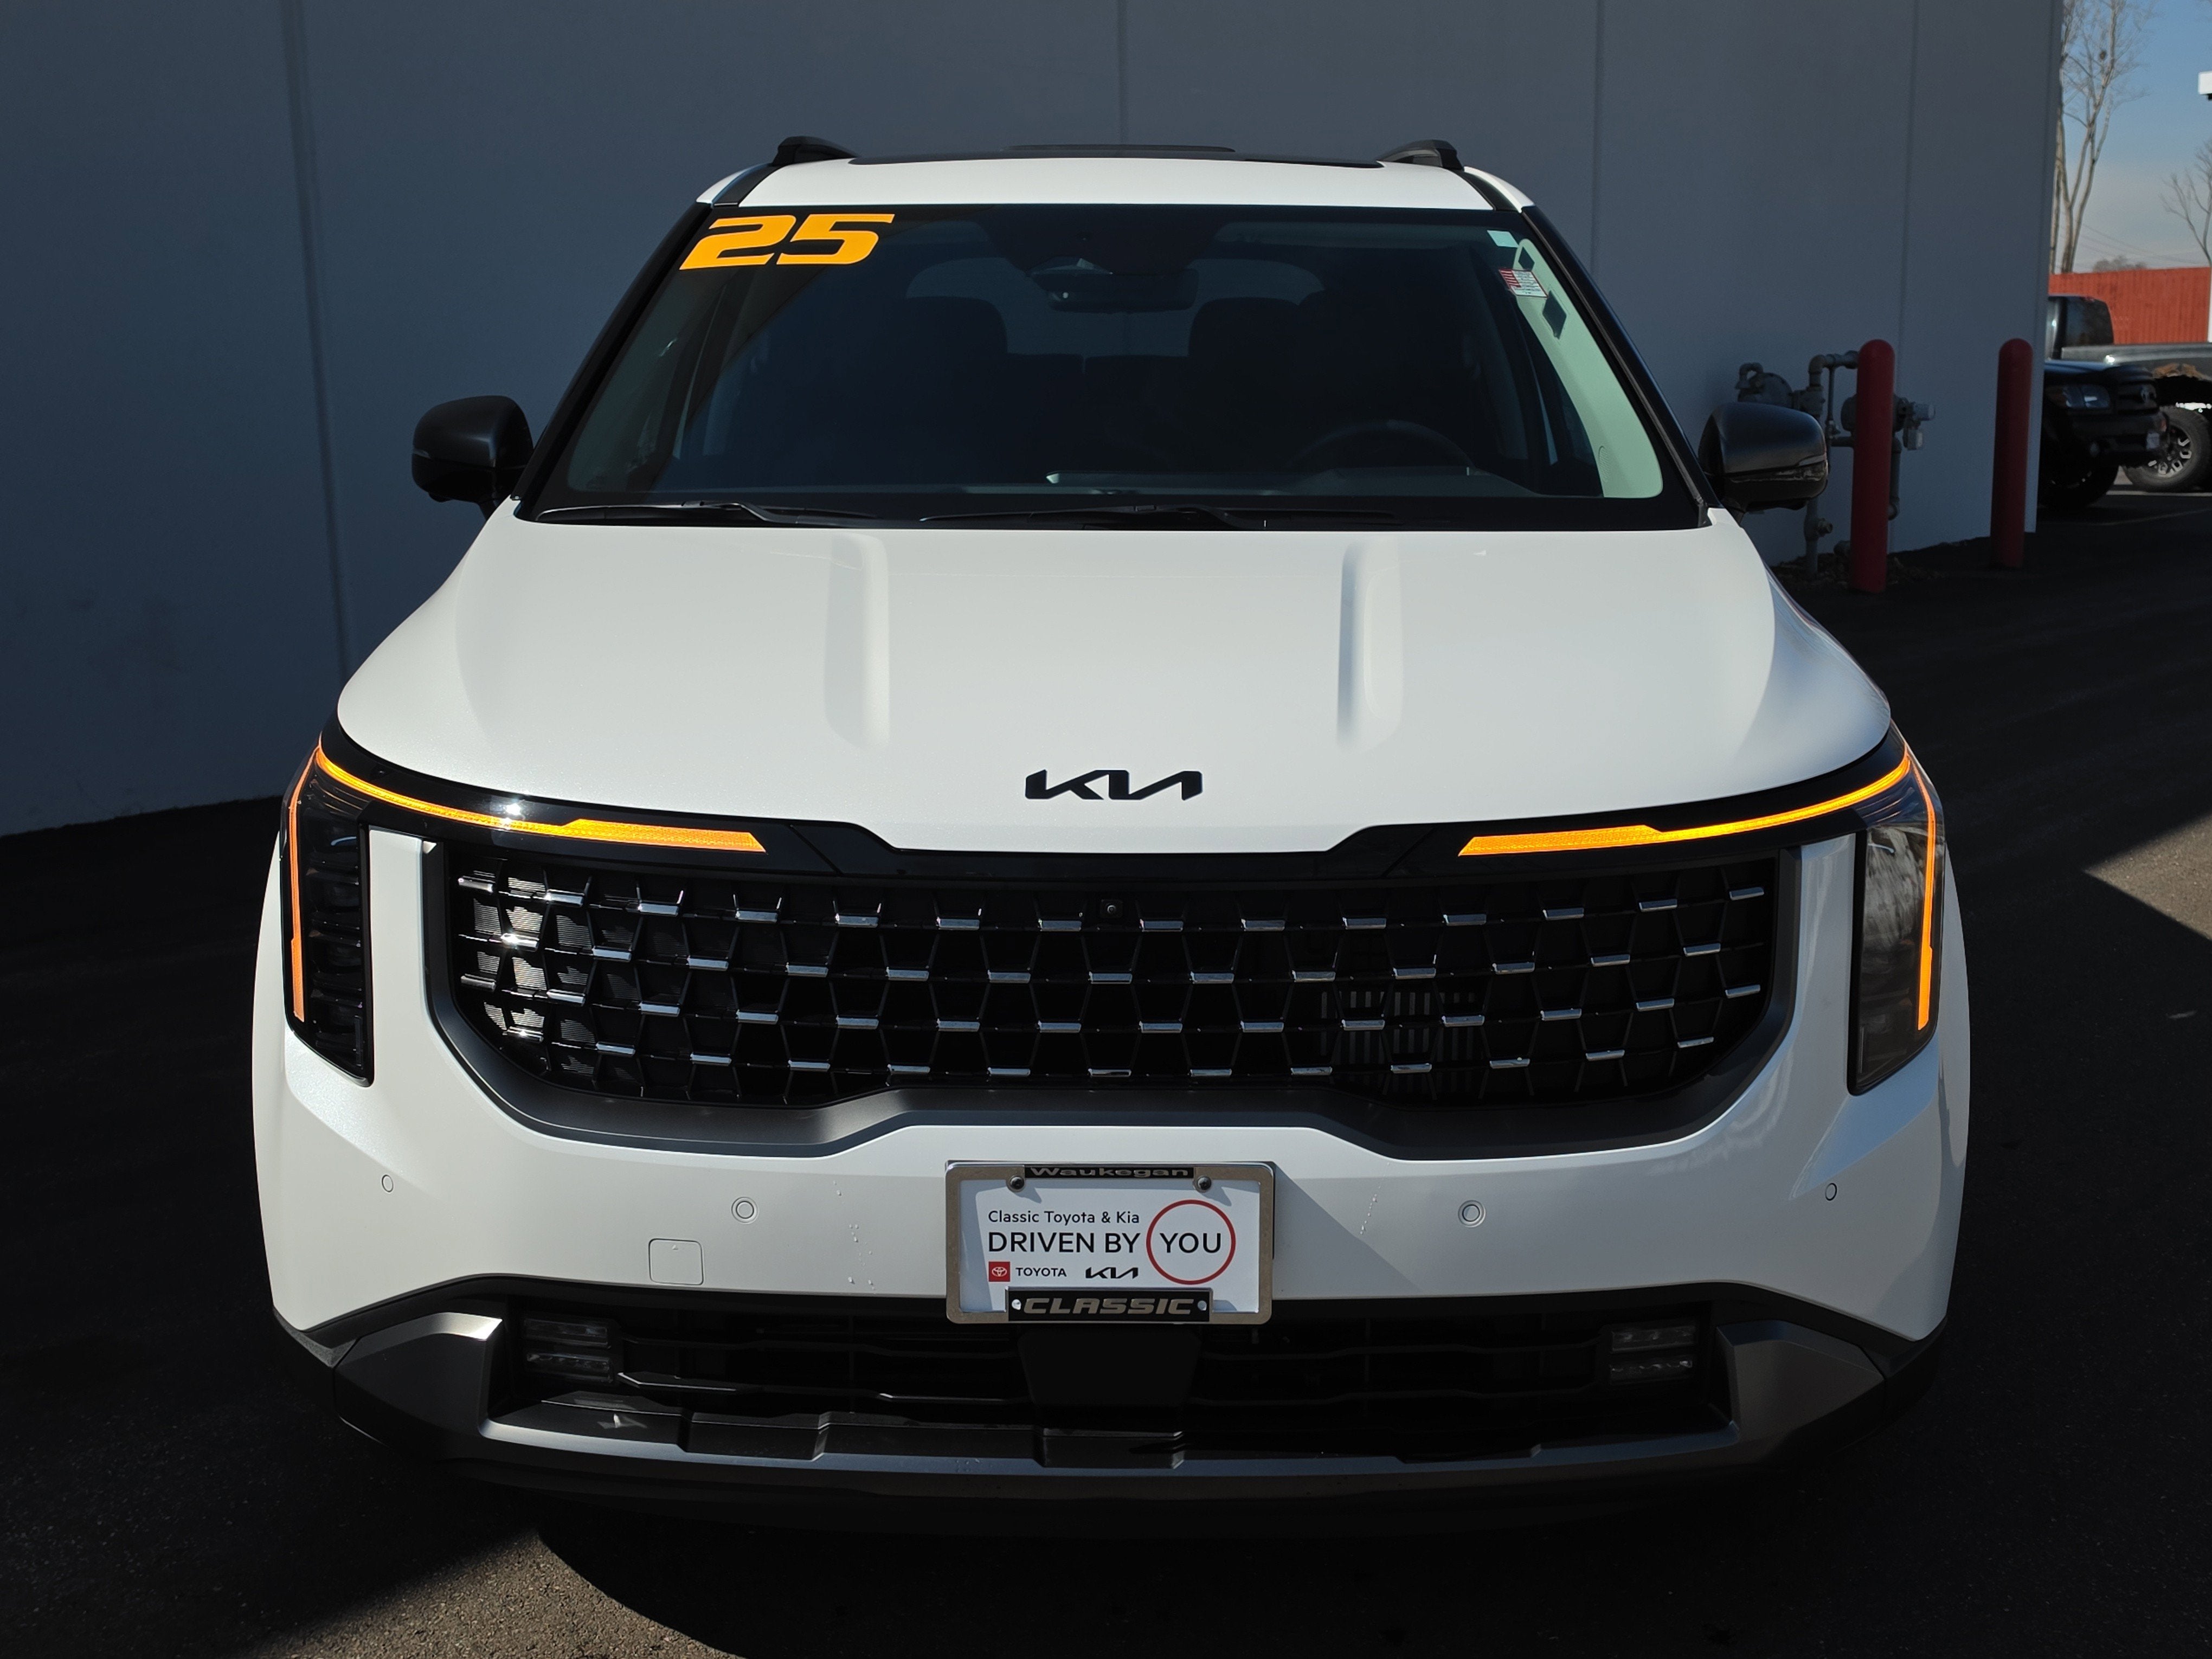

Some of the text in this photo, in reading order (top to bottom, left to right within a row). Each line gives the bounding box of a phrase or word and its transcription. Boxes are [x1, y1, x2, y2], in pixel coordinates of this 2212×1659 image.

[679, 214, 895, 270] 25
[1031, 1167, 1188, 1178] Waukegan
[988, 1210, 1140, 1226] Classic Toyota & Kia
[988, 1232, 1221, 1253] DRIVEN BY YOU
[1015, 1267, 1067, 1277] TOYOTA
[1023, 1297, 1194, 1315] CLASSIC
